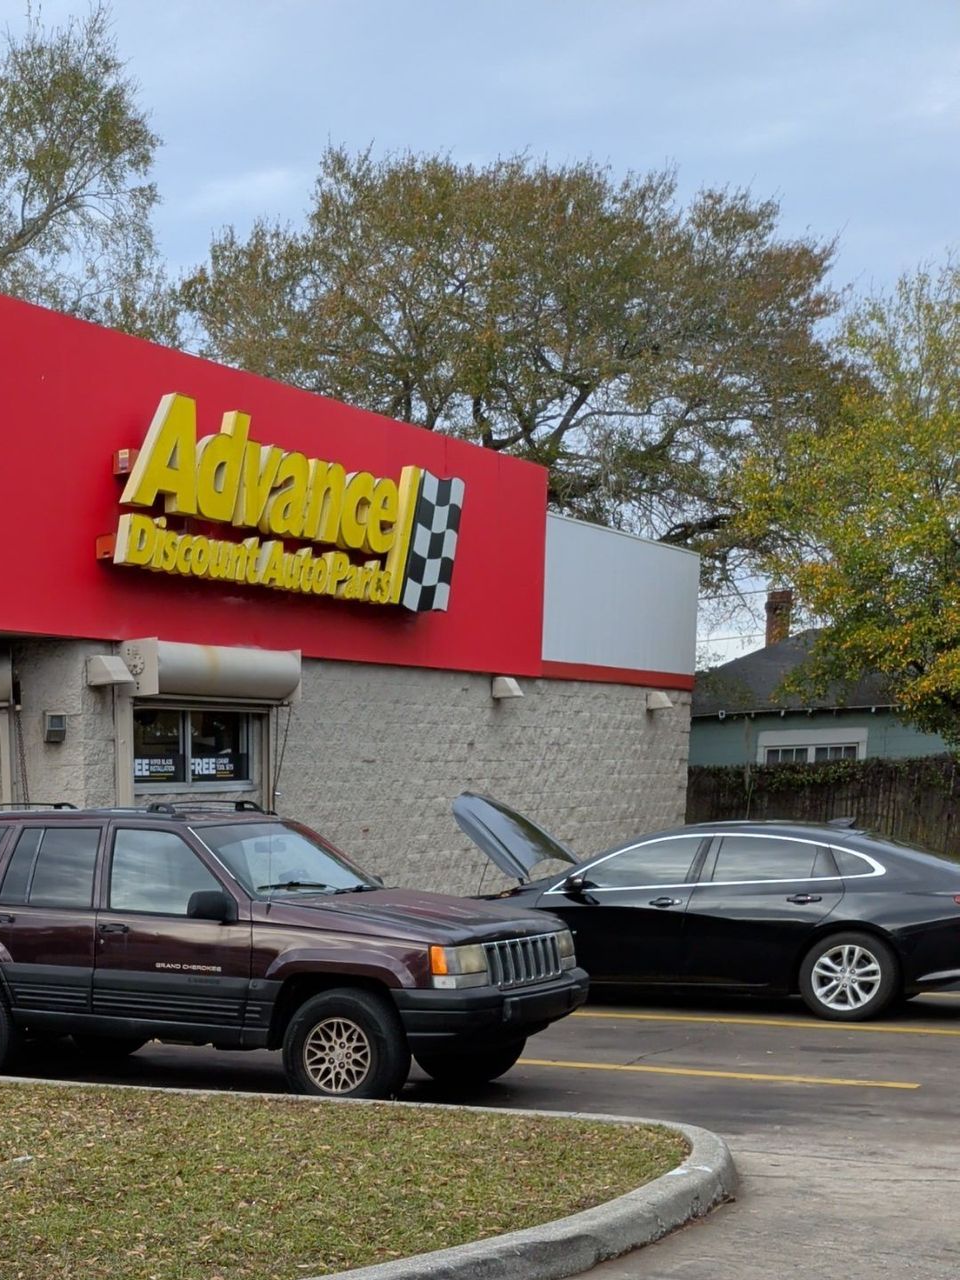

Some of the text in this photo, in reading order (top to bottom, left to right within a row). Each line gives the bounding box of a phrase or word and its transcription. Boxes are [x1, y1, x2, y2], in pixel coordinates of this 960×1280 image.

[119, 392, 397, 553] Advance
[114, 513, 391, 604] Discount Auto Parts
[134, 758, 150, 776] EE
[182, 963, 222, 972] CHEROKEE
